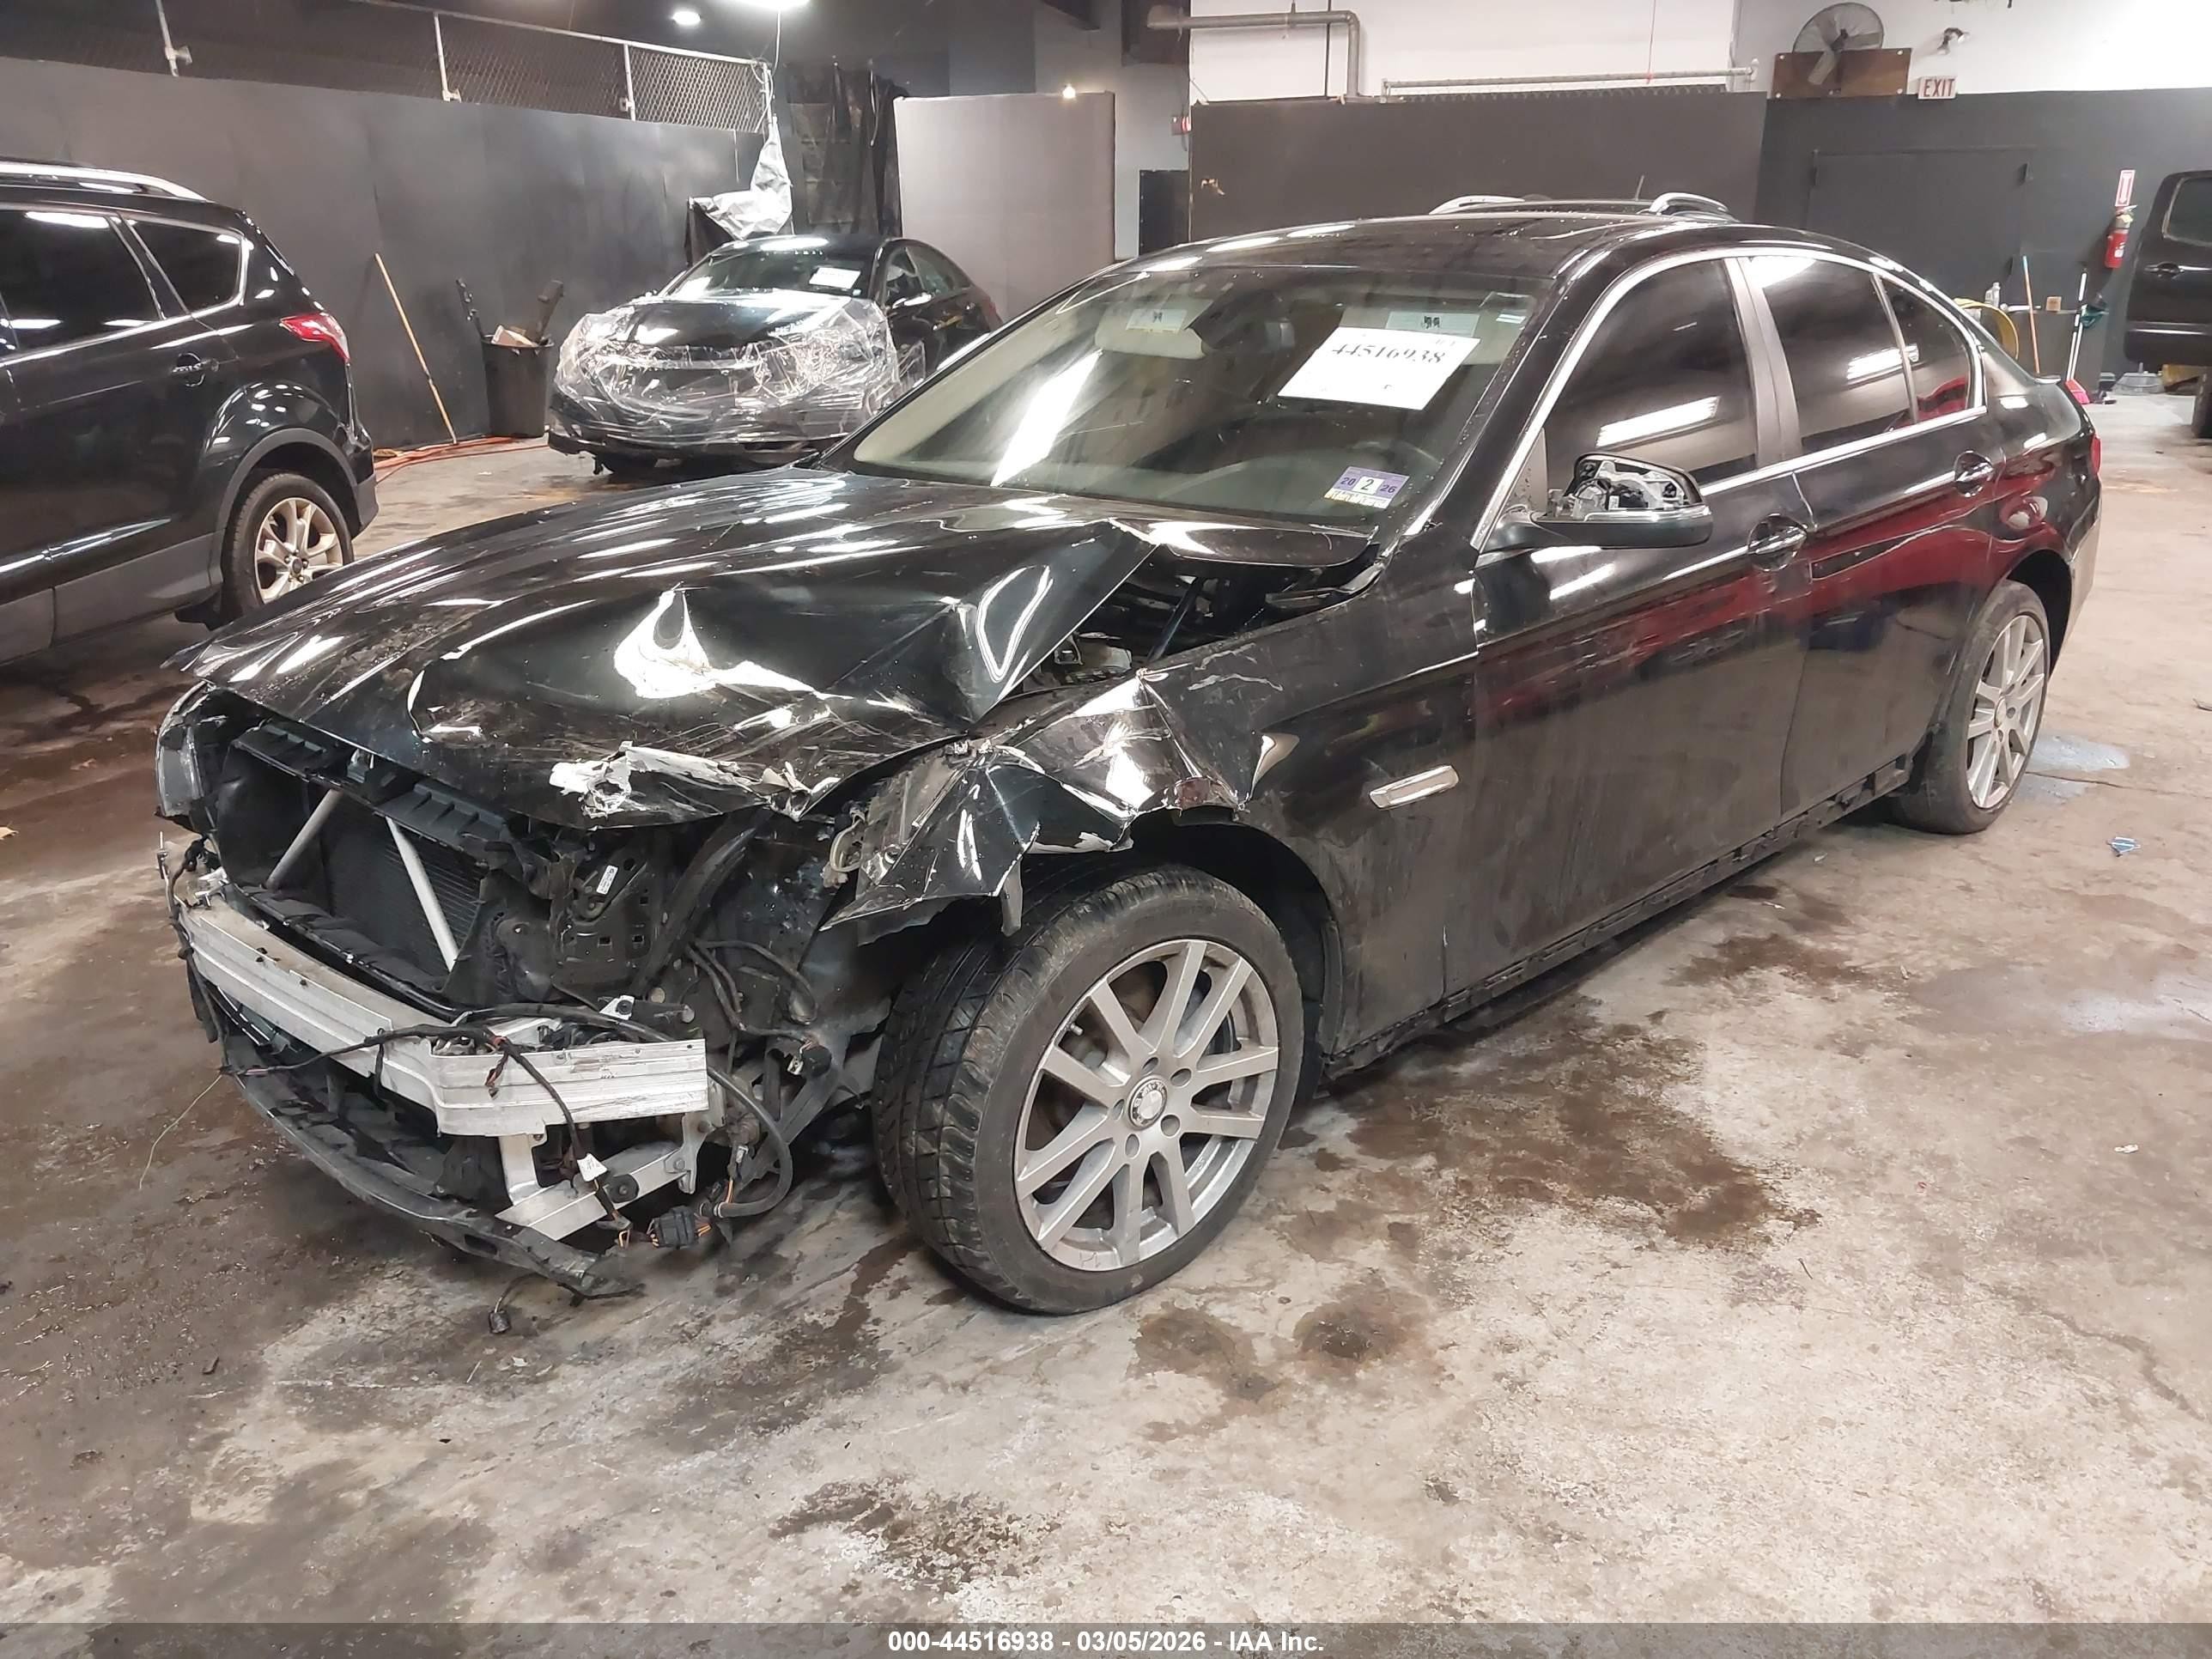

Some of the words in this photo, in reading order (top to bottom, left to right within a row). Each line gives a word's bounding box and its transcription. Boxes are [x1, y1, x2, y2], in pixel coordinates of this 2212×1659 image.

[1923, 78, 1955, 97] EXIT
[1332, 343, 1446, 364] 44516938
[1340, 477, 1357, 486] 20
[1360, 478, 1375, 491] 2
[1380, 484, 1397, 494] 26
